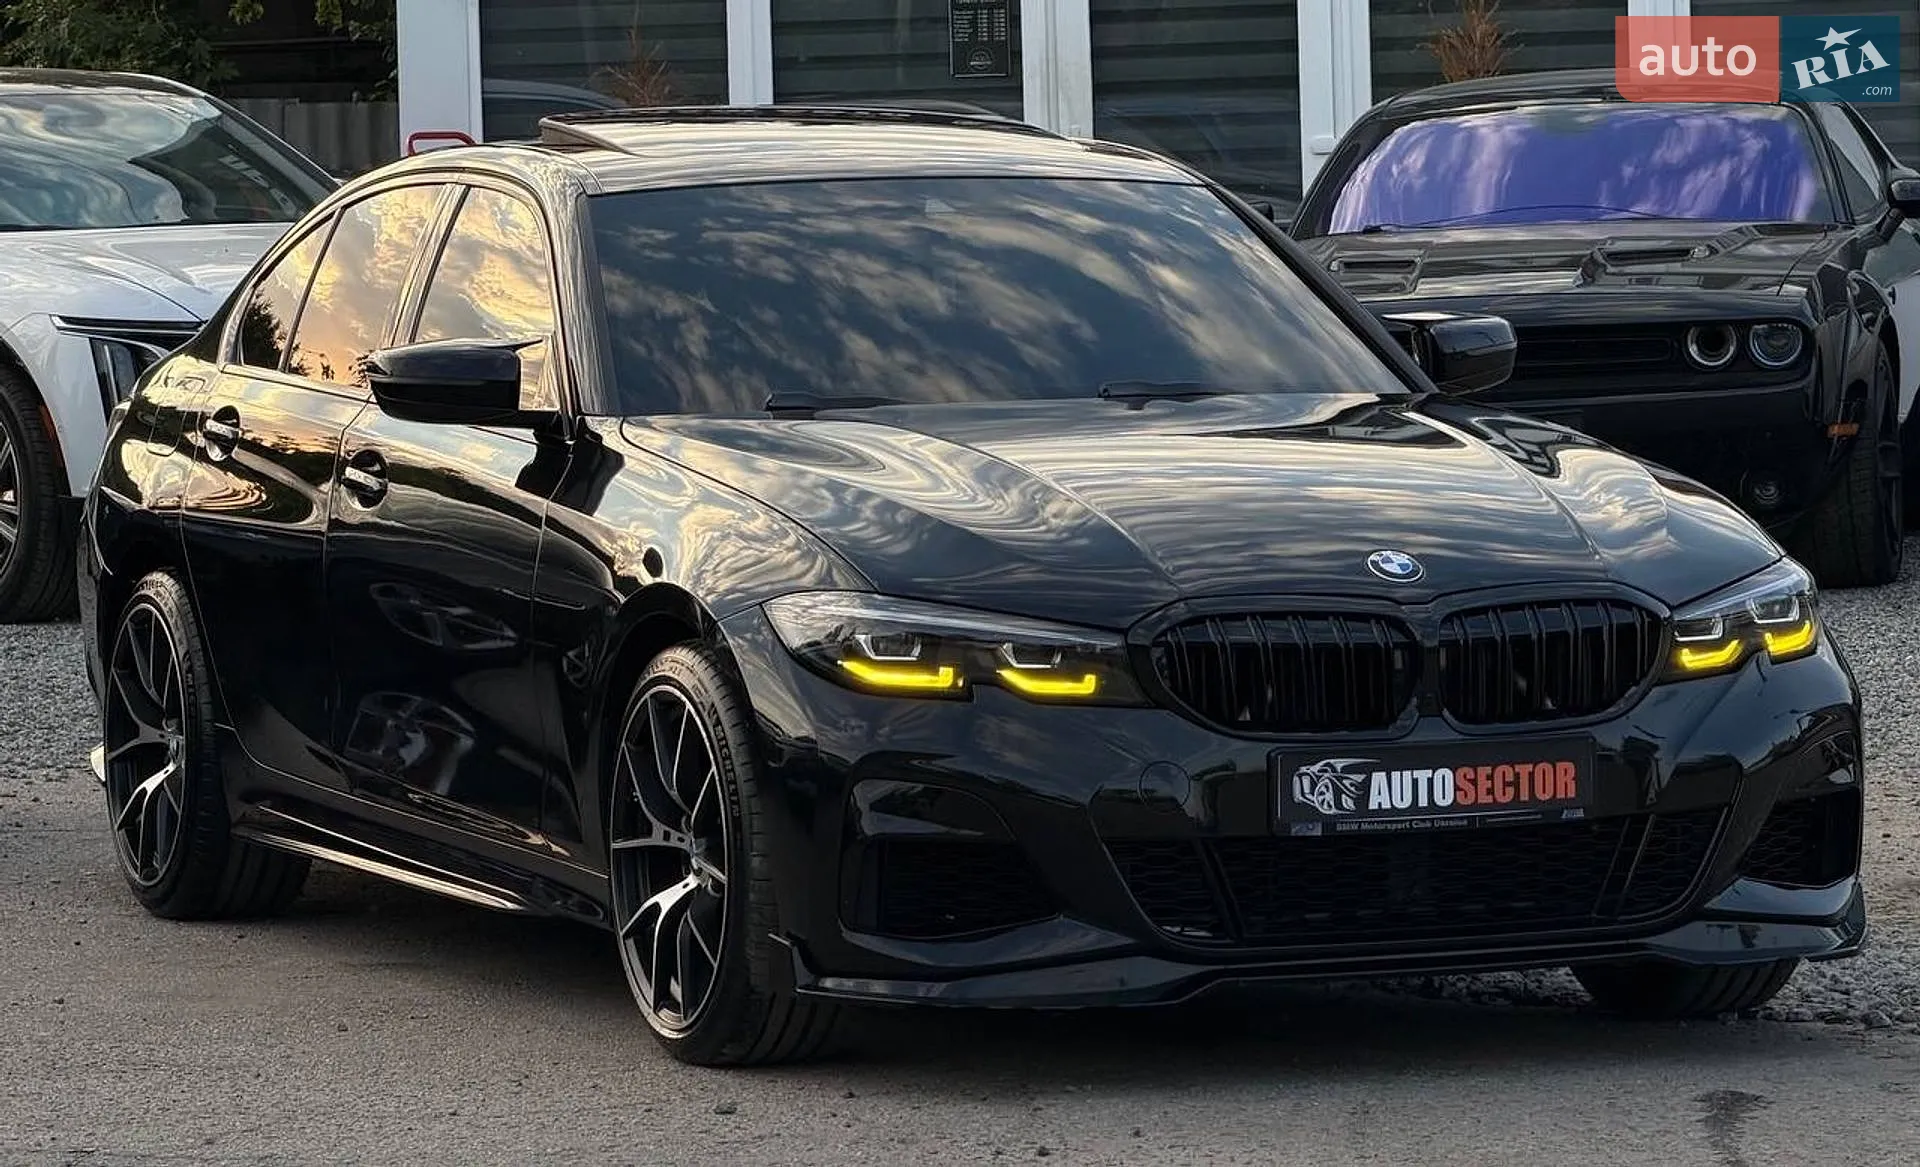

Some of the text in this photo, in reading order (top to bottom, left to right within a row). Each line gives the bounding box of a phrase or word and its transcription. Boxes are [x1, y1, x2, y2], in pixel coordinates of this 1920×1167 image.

[1368, 761, 1577, 811] AUTOSECTOR
[1336, 822, 1359, 832] BMW
[1361, 820, 1410, 831] Motorsport
[1412, 819, 1432, 829] Club
